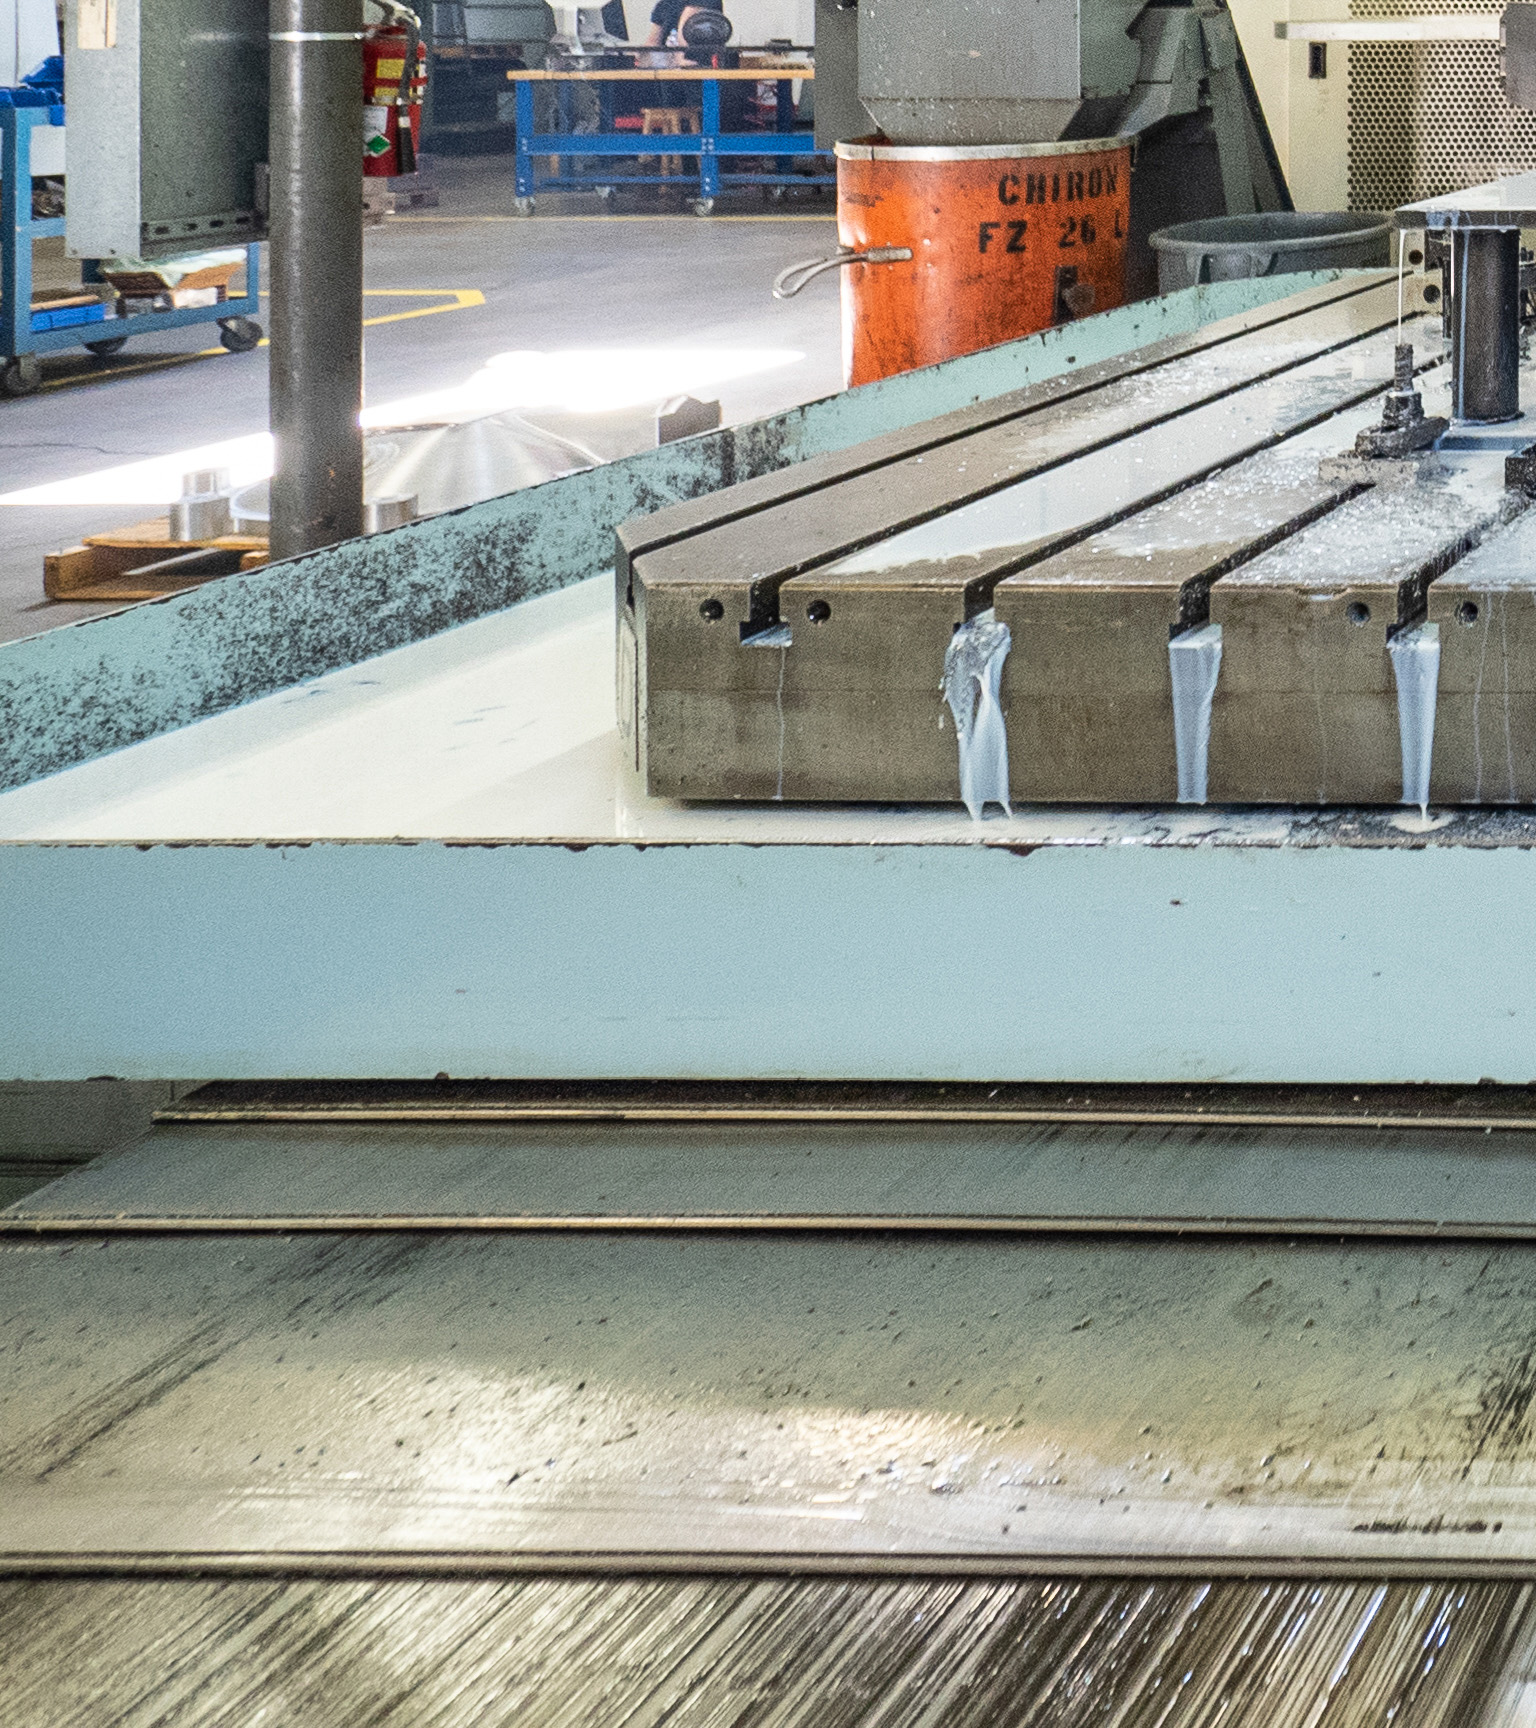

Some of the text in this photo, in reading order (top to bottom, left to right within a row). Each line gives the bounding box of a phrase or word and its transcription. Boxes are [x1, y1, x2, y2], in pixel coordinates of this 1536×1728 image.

[998, 165, 1118, 206] CHIRON
[979, 220, 1028, 253] FZ
[1058, 214, 1097, 248] 26
